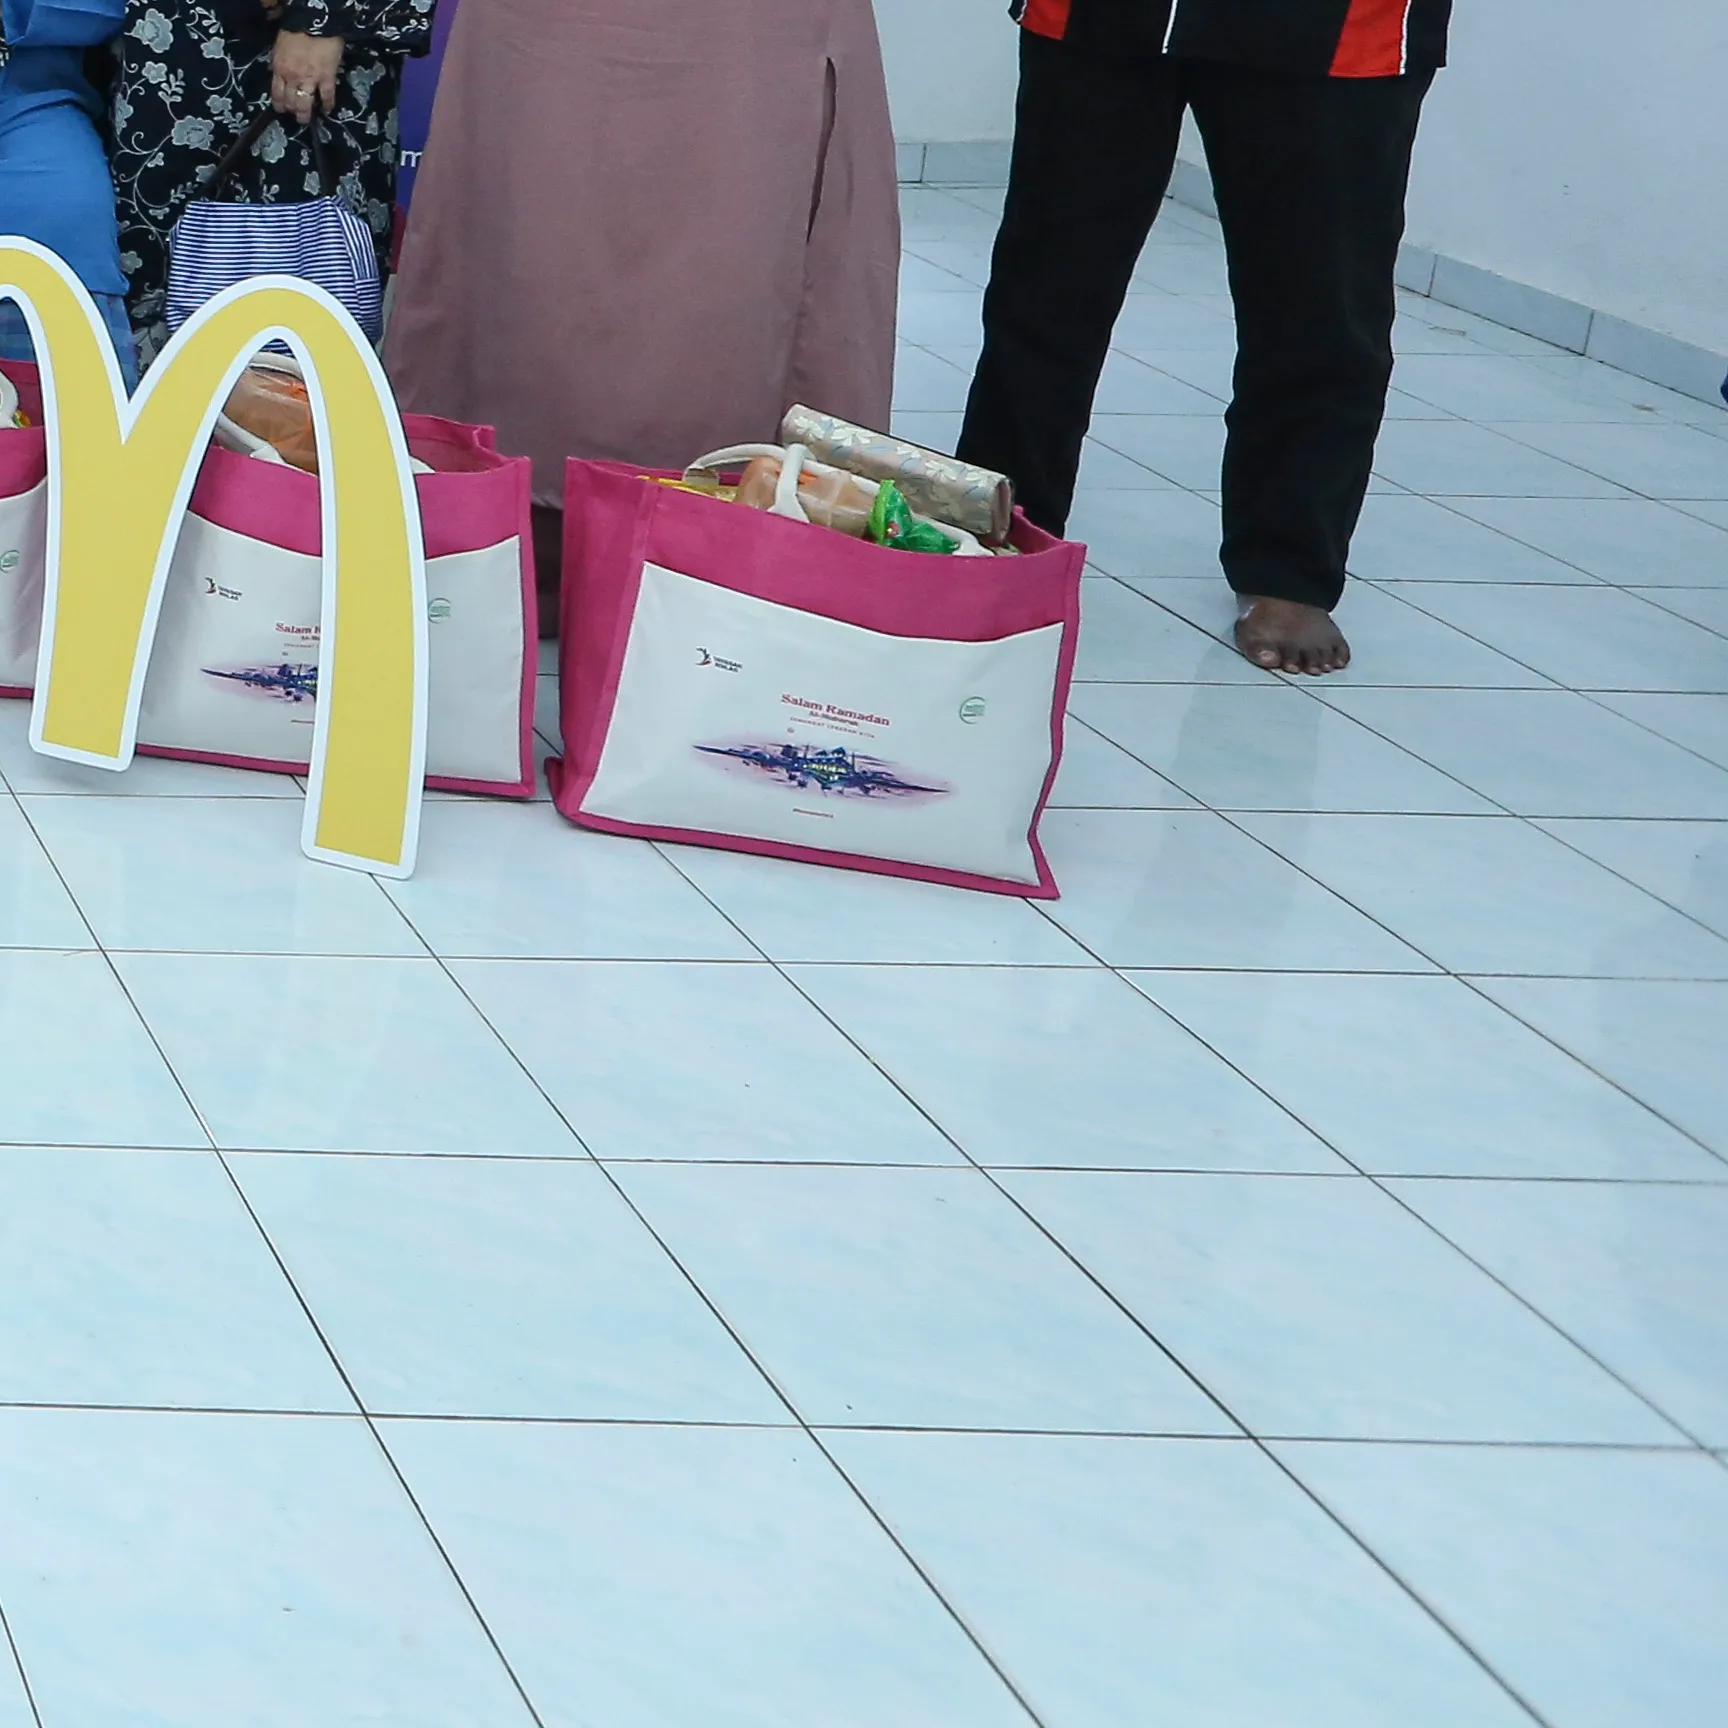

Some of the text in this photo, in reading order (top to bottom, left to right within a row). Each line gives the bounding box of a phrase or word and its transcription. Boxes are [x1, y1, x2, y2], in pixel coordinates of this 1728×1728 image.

[275, 622, 312, 635] Salam
[781, 693, 891, 726] Salam Ramadan
